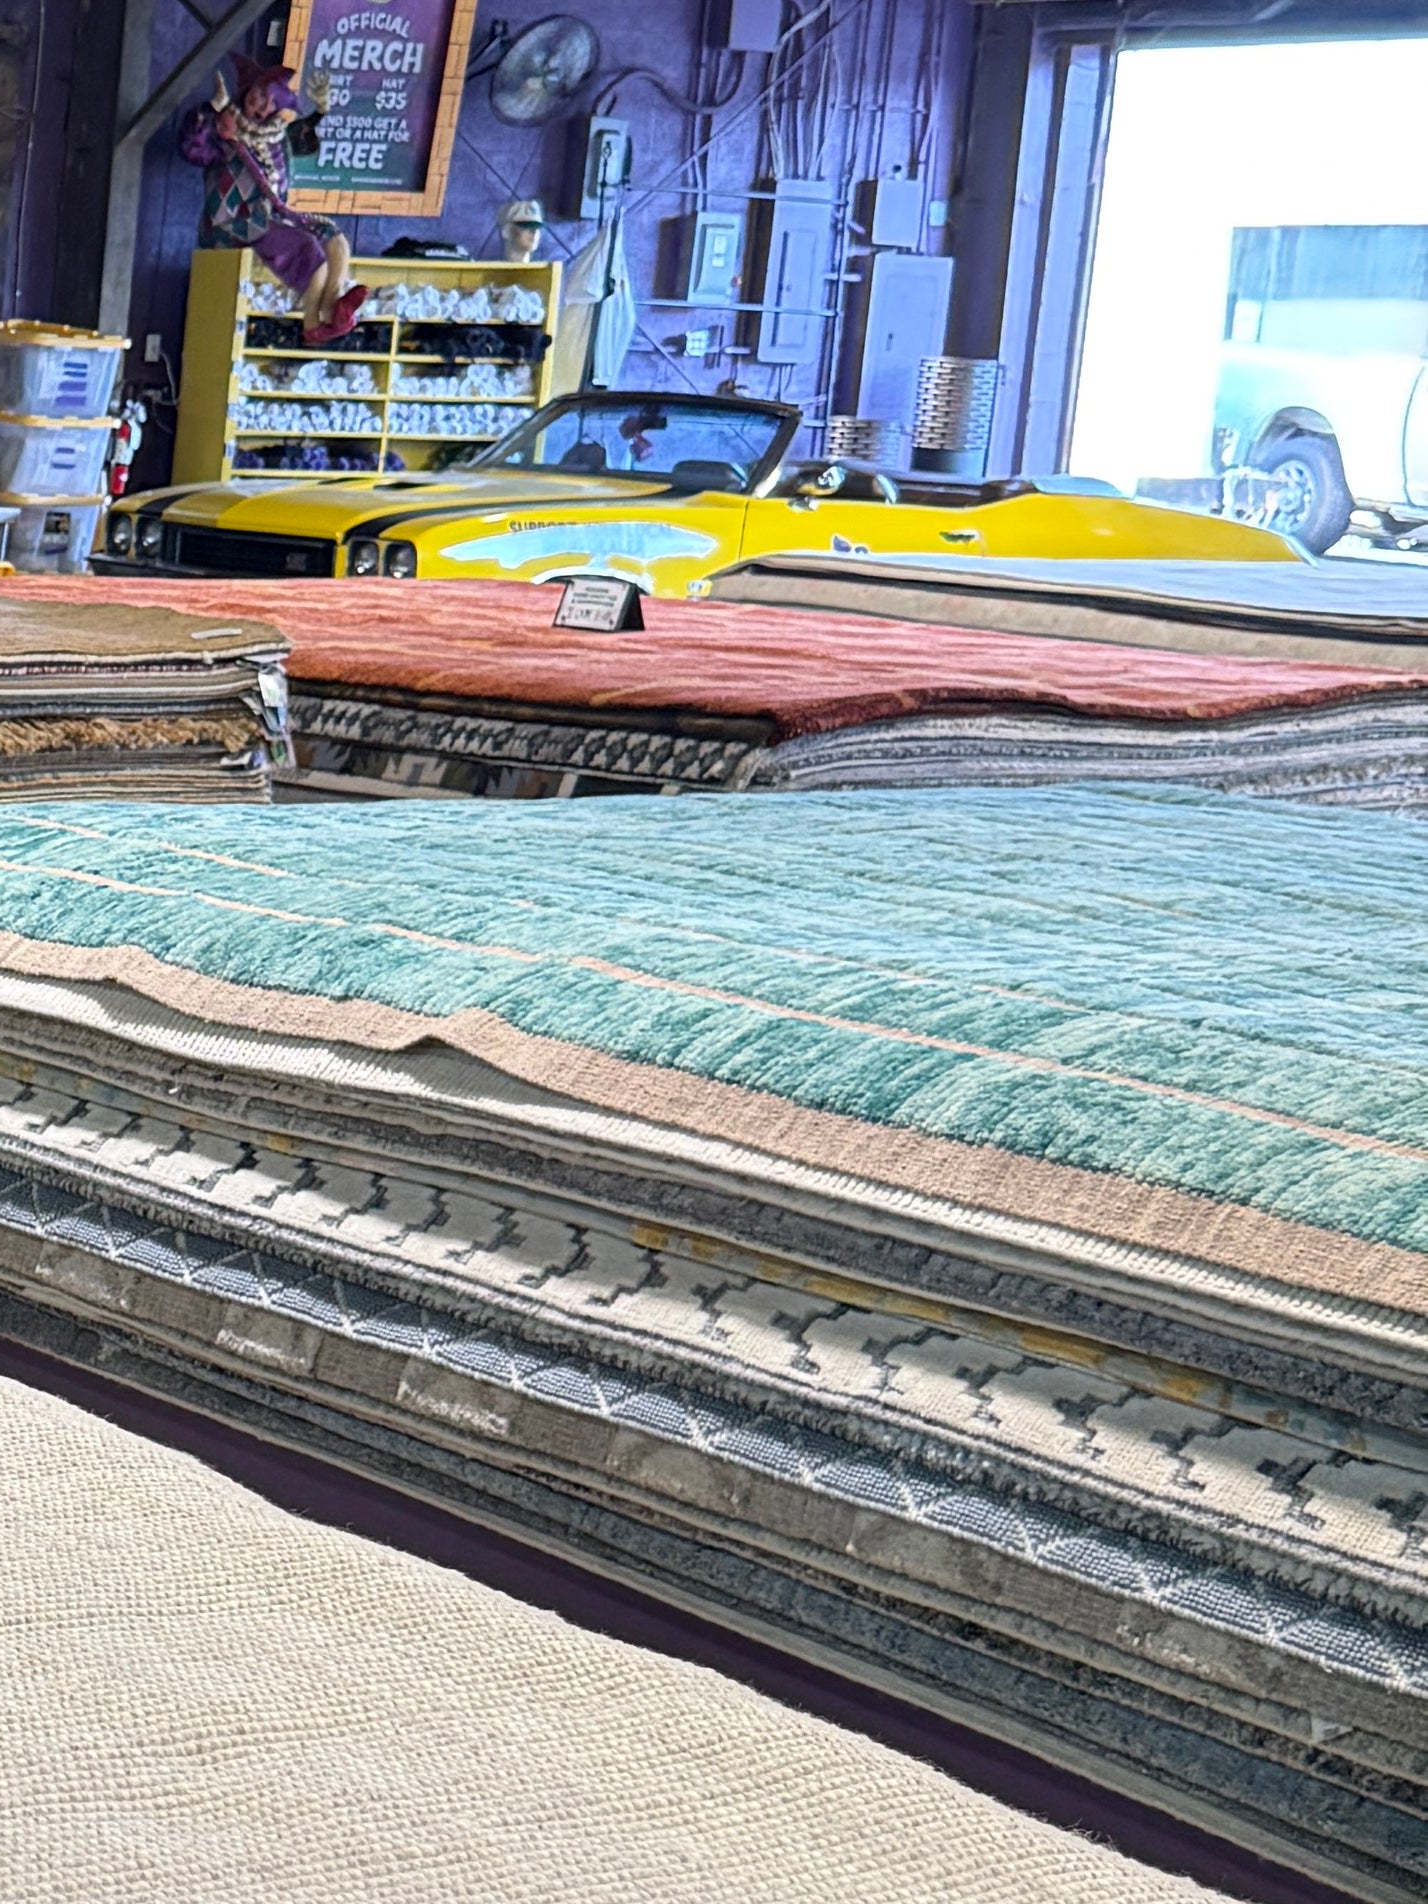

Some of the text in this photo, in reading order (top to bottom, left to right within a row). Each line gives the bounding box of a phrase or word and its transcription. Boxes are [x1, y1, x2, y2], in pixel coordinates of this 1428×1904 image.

[337, 12, 411, 38] OFFICIAL
[314, 38, 424, 73] MERCH
[382, 78, 406, 90] HAT
[375, 91, 408, 111] $35
[317, 141, 388, 170] FREE
